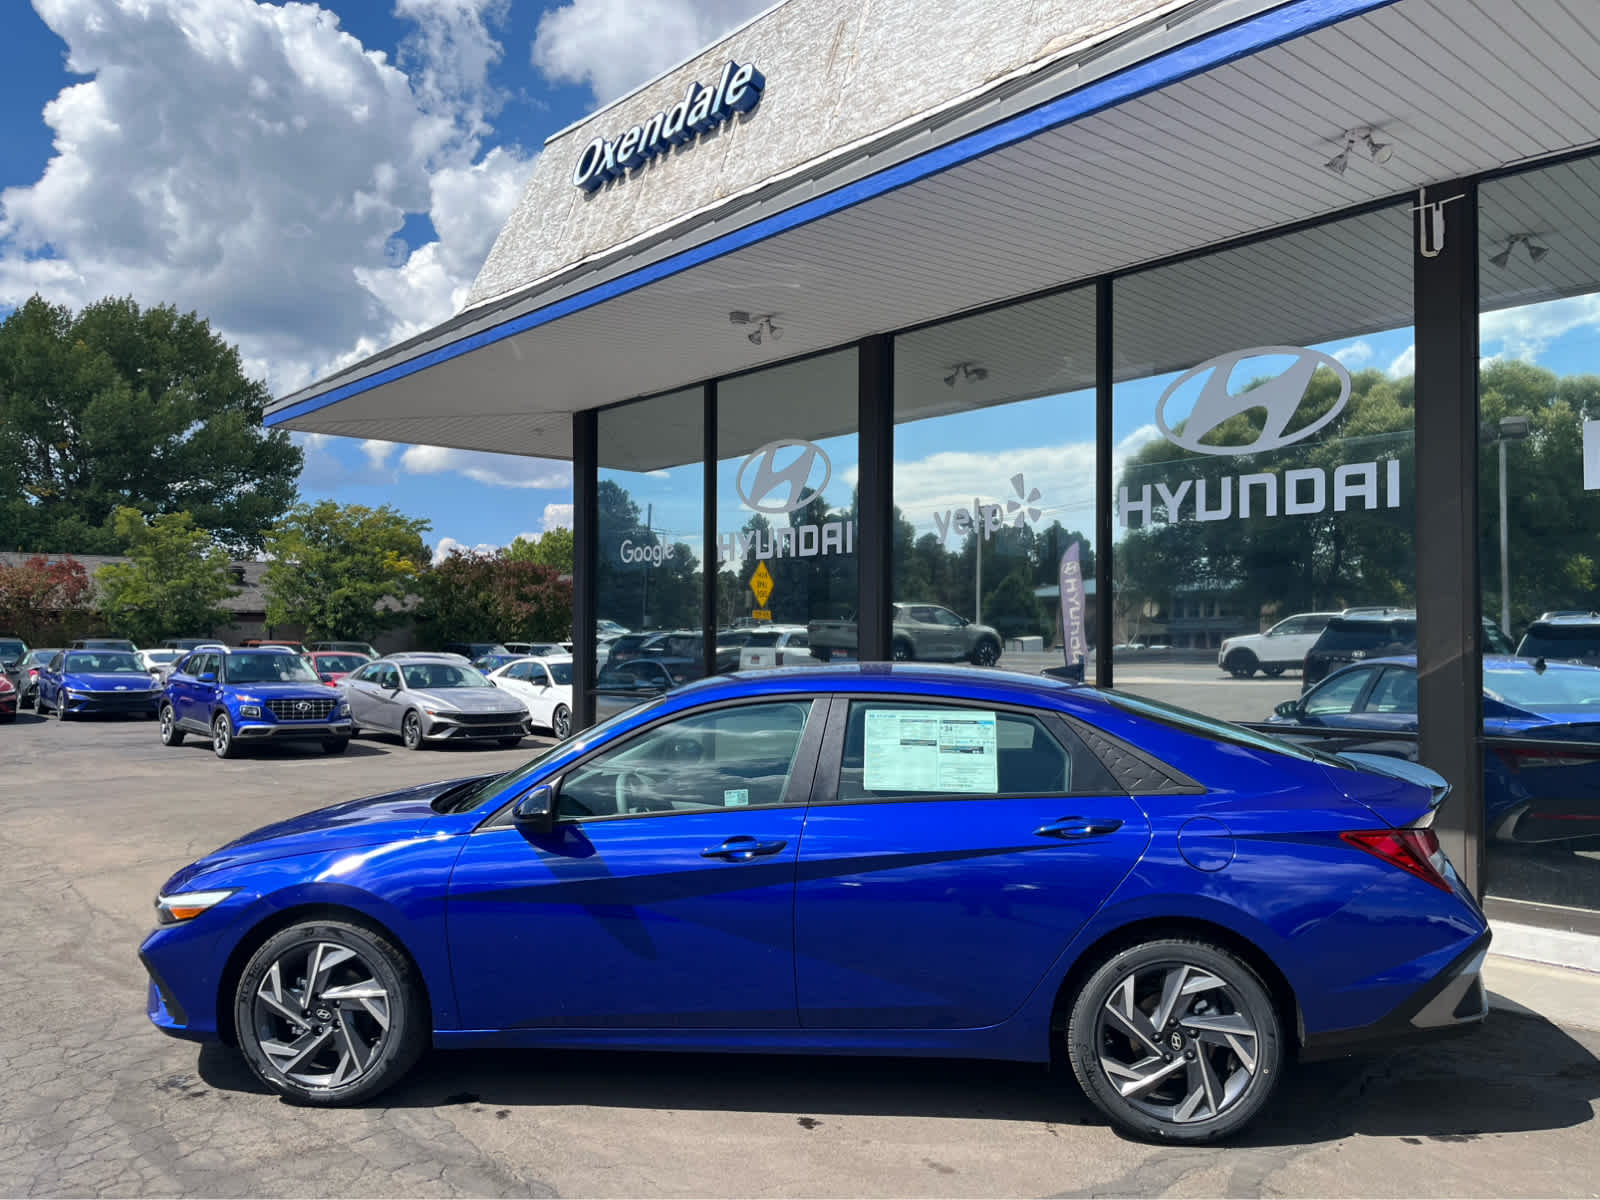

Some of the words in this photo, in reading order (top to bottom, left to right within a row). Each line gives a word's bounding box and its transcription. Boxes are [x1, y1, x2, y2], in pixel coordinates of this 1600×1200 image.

[572, 60, 765, 192] Oxendale
[934, 497, 1004, 545] yelp
[1118, 459, 1401, 528] HYUNDAI
[620, 537, 675, 568] Google
[717, 521, 853, 562] HYUNDAI
[1063, 578, 1083, 664] HYUNDA
